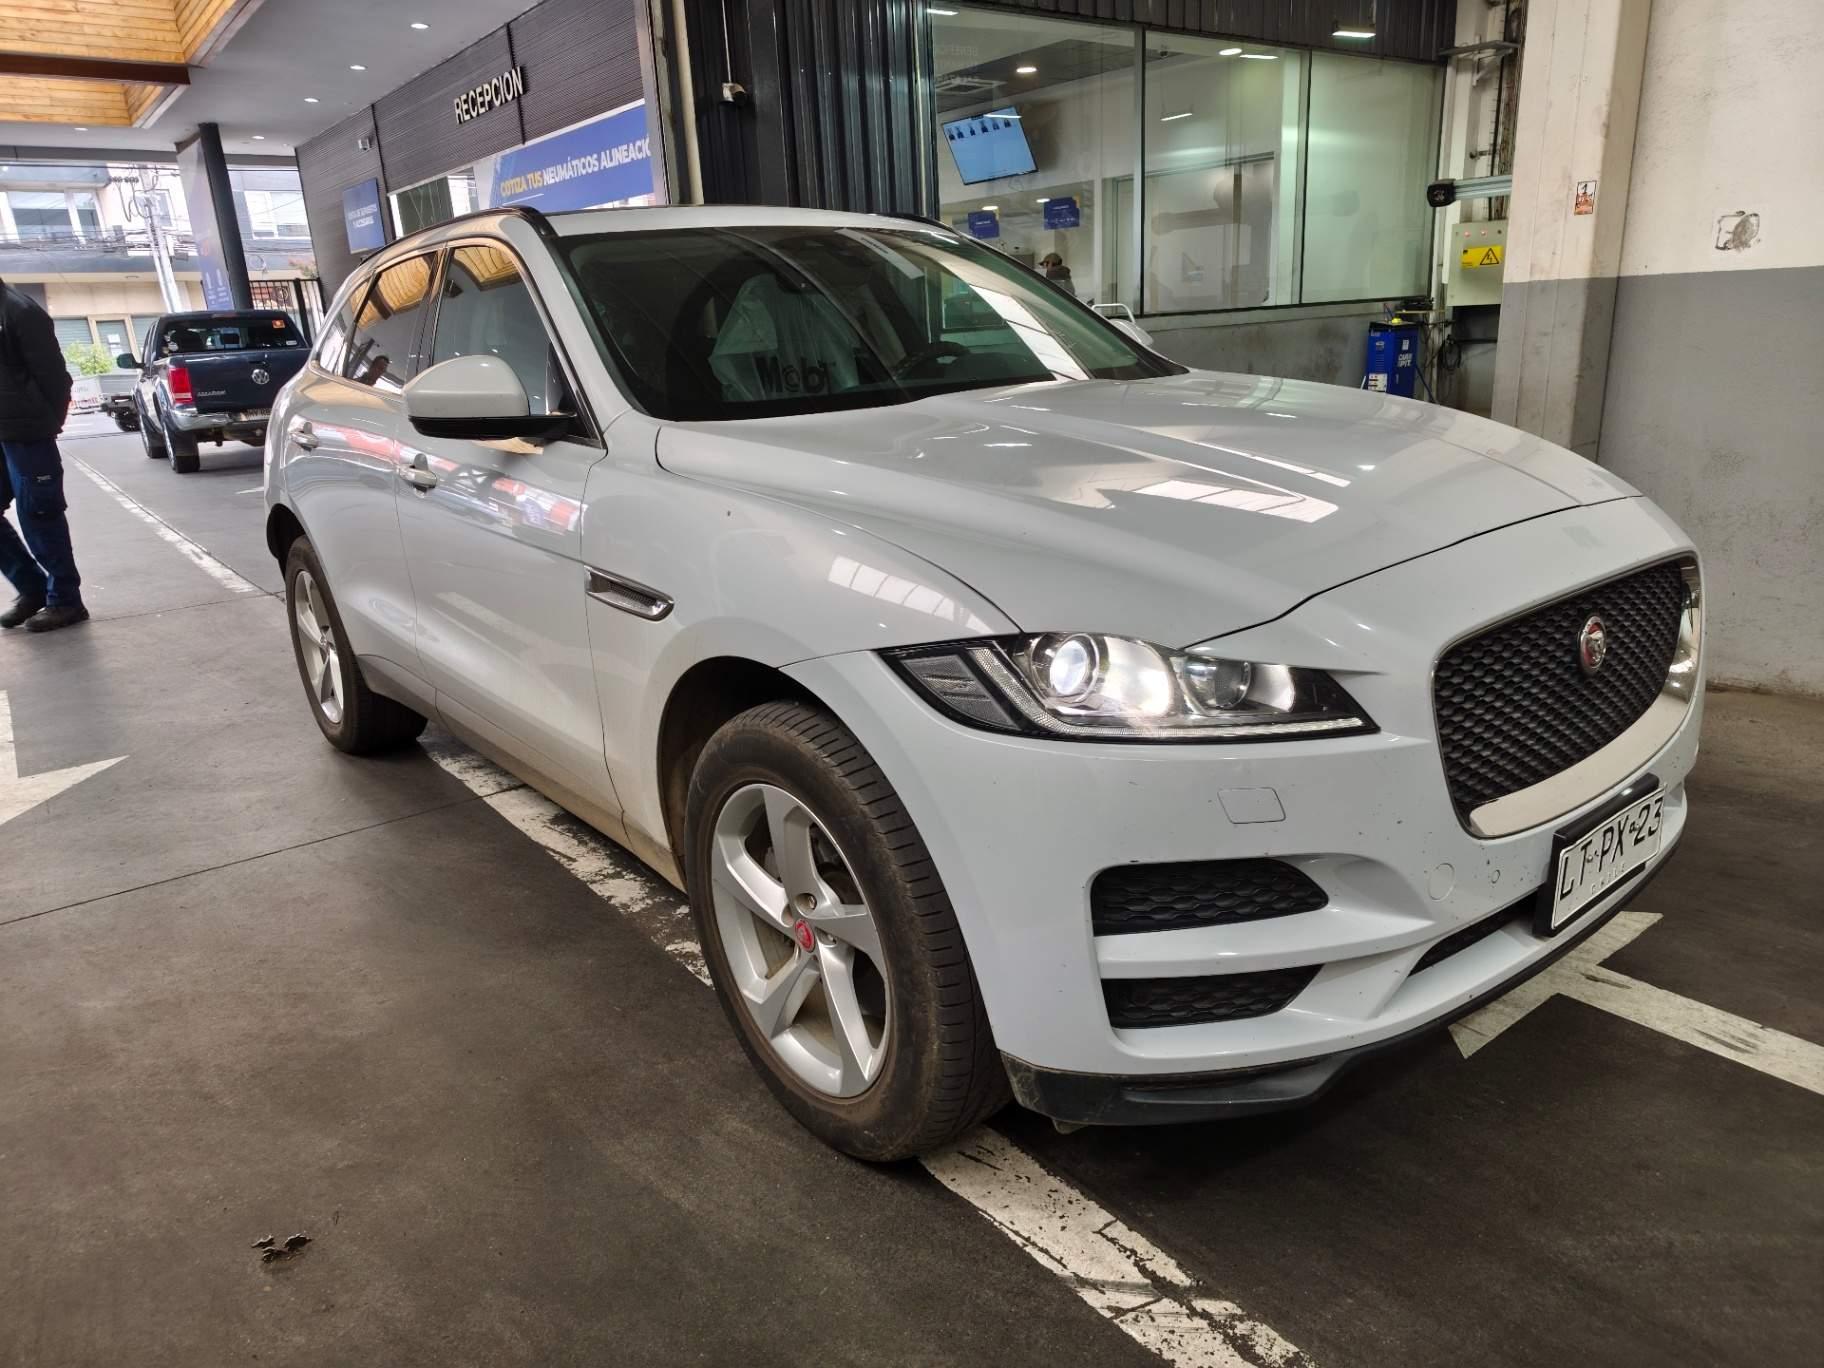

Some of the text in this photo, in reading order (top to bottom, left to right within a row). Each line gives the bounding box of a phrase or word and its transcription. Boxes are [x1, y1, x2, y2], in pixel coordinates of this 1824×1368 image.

[454, 66, 524, 124] RECEPCION
[501, 176, 527, 197] COTIZA
[528, 170, 544, 189] TUS
[543, 154, 599, 185] NEUMÁTICOS
